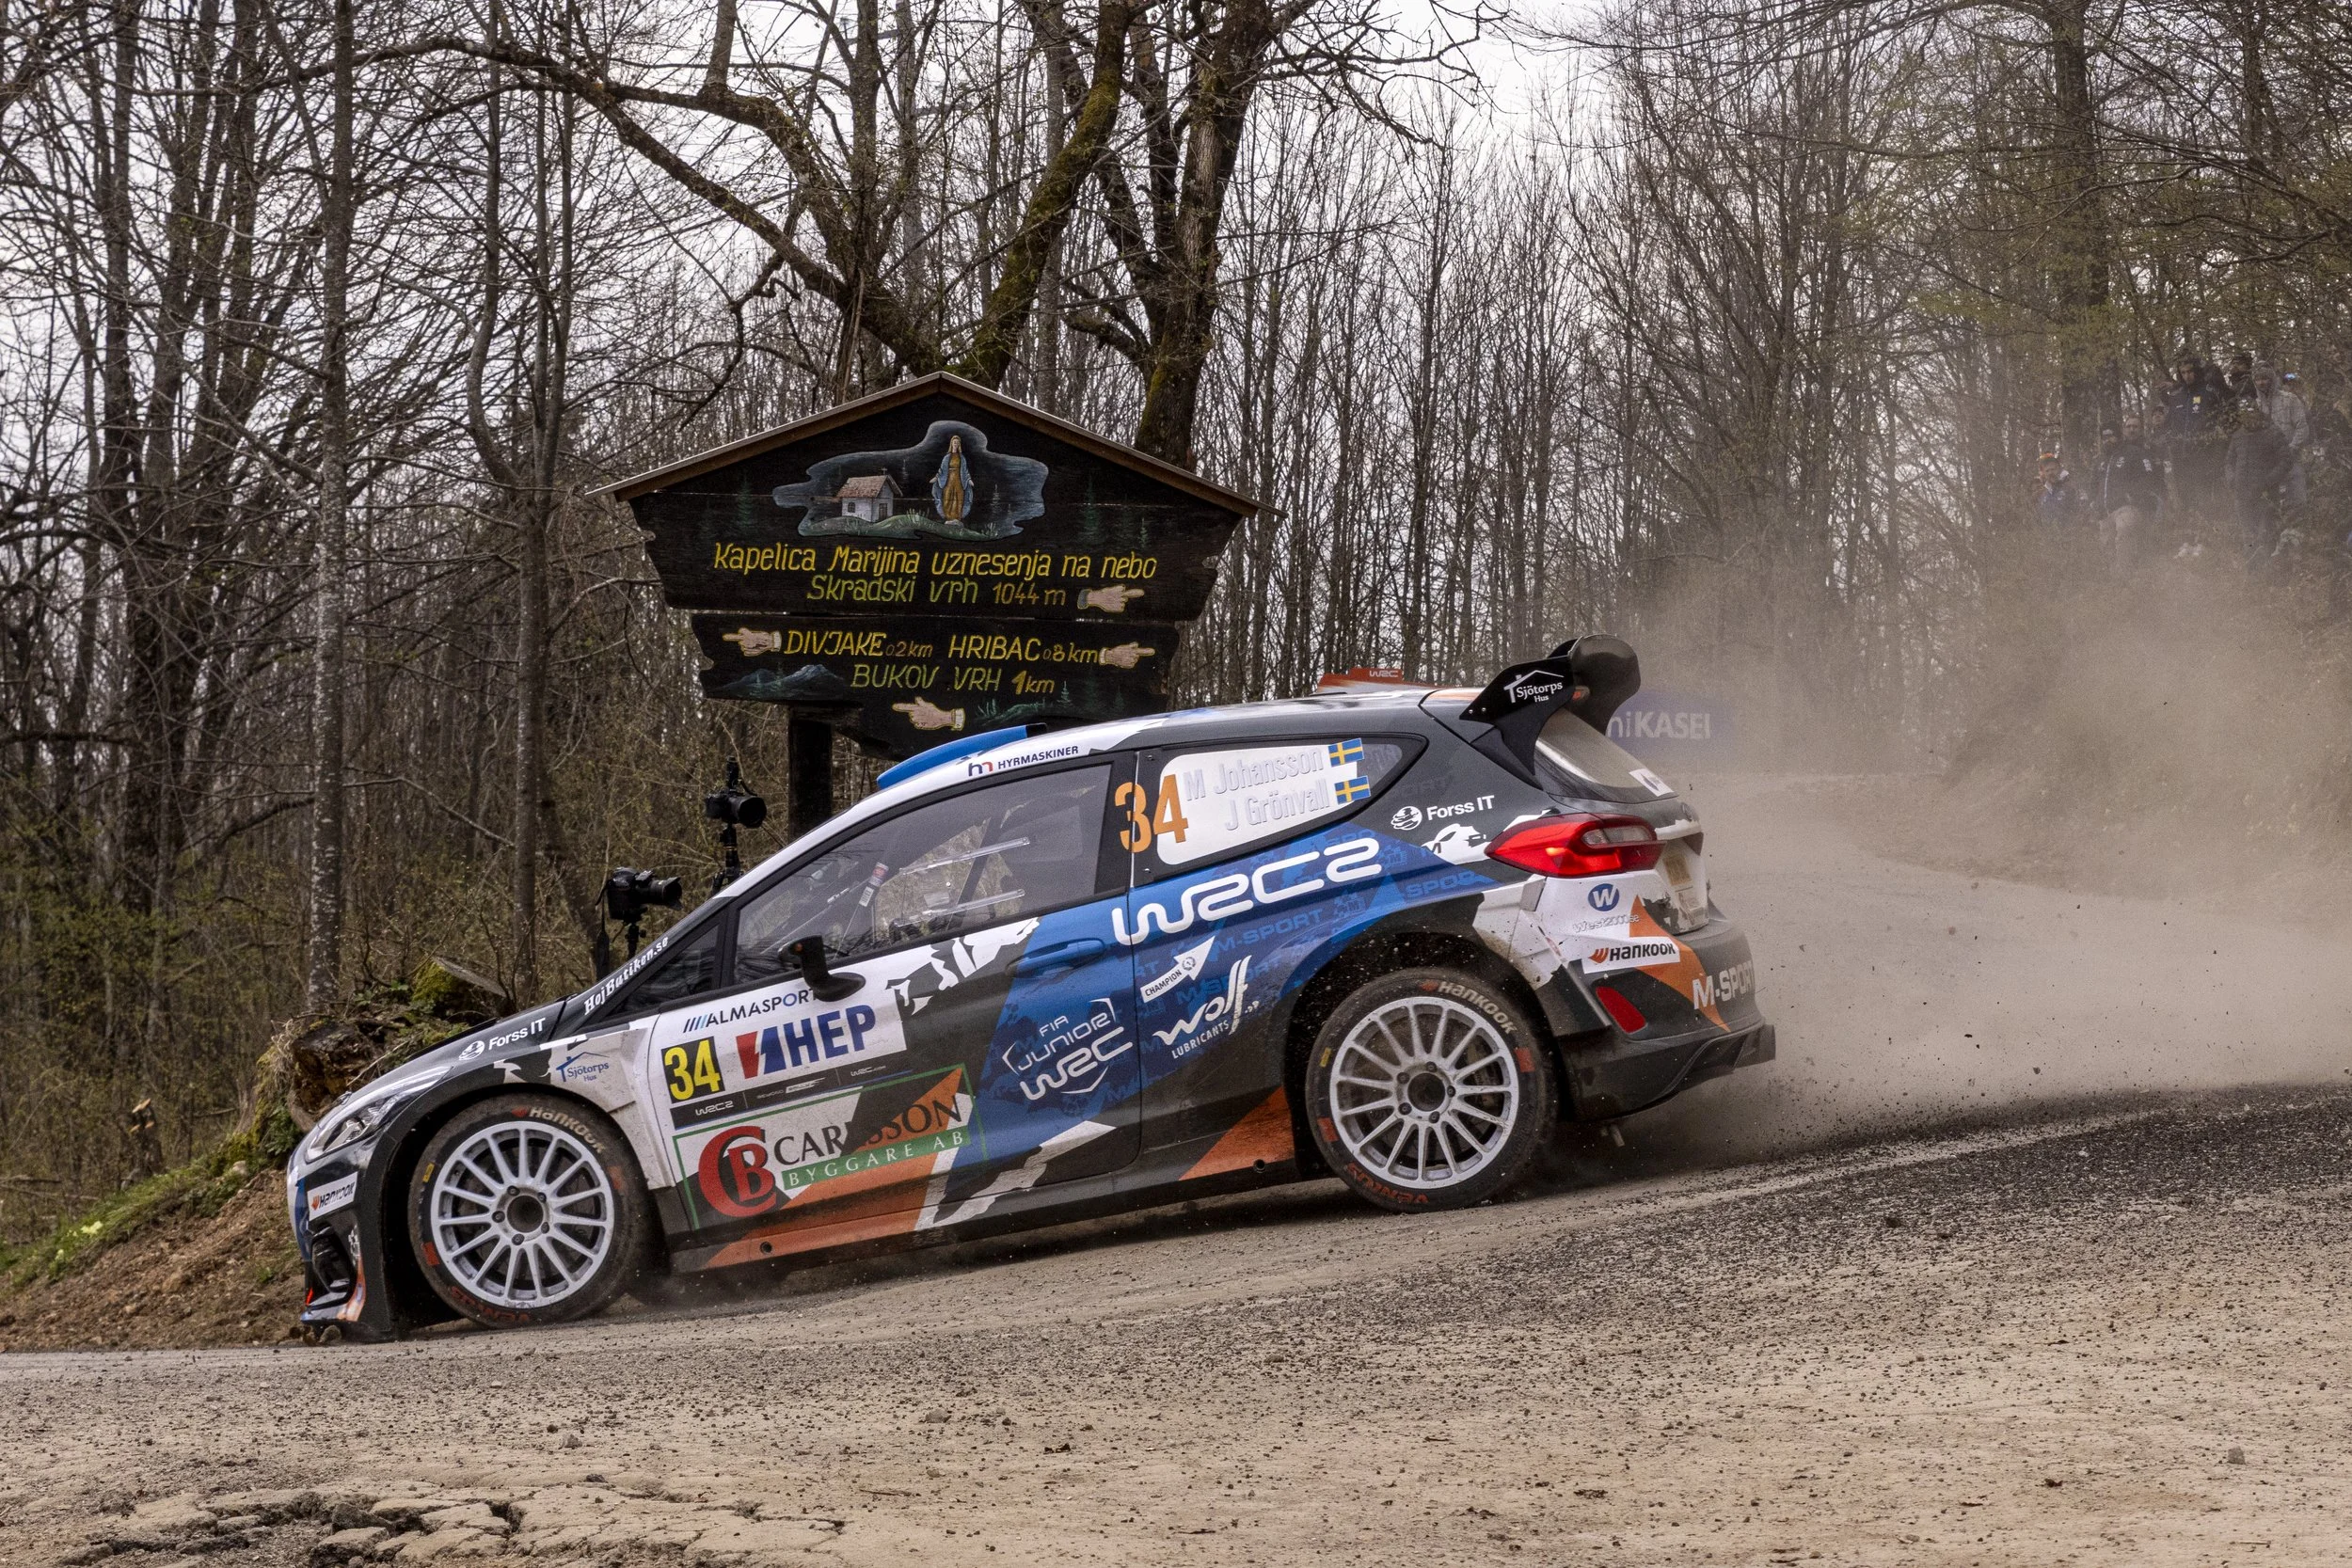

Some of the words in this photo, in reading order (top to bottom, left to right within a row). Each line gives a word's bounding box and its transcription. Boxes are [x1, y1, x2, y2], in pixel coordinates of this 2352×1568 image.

[713, 542, 817, 575] Kapelica
[828, 545, 921, 577] Marijina
[1061, 554, 1091, 578] na
[1100, 551, 1157, 578] nebo
[807, 575, 916, 602] Skradski
[993, 581, 1039, 605] 1044
[1043, 588, 1066, 606] m
[784, 630, 887, 657] DIVJAKE
[948, 634, 1041, 661] HRIBAC
[850, 664, 940, 689] BUKOV
[954, 666, 1002, 691] VRH
[1369, 670, 1399, 678] WRC
[1516, 681, 1563, 700] Sjötorps
[1534, 694, 1549, 703] Hus
[997, 746, 1079, 769] HYRMASKINER
[1184, 768, 1206, 801] M
[1213, 748, 1325, 795] Johansson
[1114, 774, 1189, 853] 34
[1224, 800, 1239, 831] J
[1245, 779, 1330, 826] Grönvall
[1426, 802, 1475, 821] Forss
[1477, 795, 1495, 811] IT
[1111, 837, 1382, 946] WRC2
[1145, 970, 1182, 997] CHAMPION
[706, 989, 814, 1027] ALMASPOR
[488, 1029, 528, 1051] Forss
[530, 1018, 546, 1035] IT
[1018, 1012, 1111, 1071] JUNIOR
[1040, 1015, 1069, 1037] FIA
[1171, 1020, 1230, 1059] LUBRICANTS
[567, 1062, 610, 1080] Sjötorps
[664, 1039, 722, 1101] 34
[1019, 1026, 1134, 1101] WRC
[695, 1101, 734, 1116] WRC2
[789, 1143, 913, 1187] BYGGARE
[933, 1131, 963, 1148] AB
